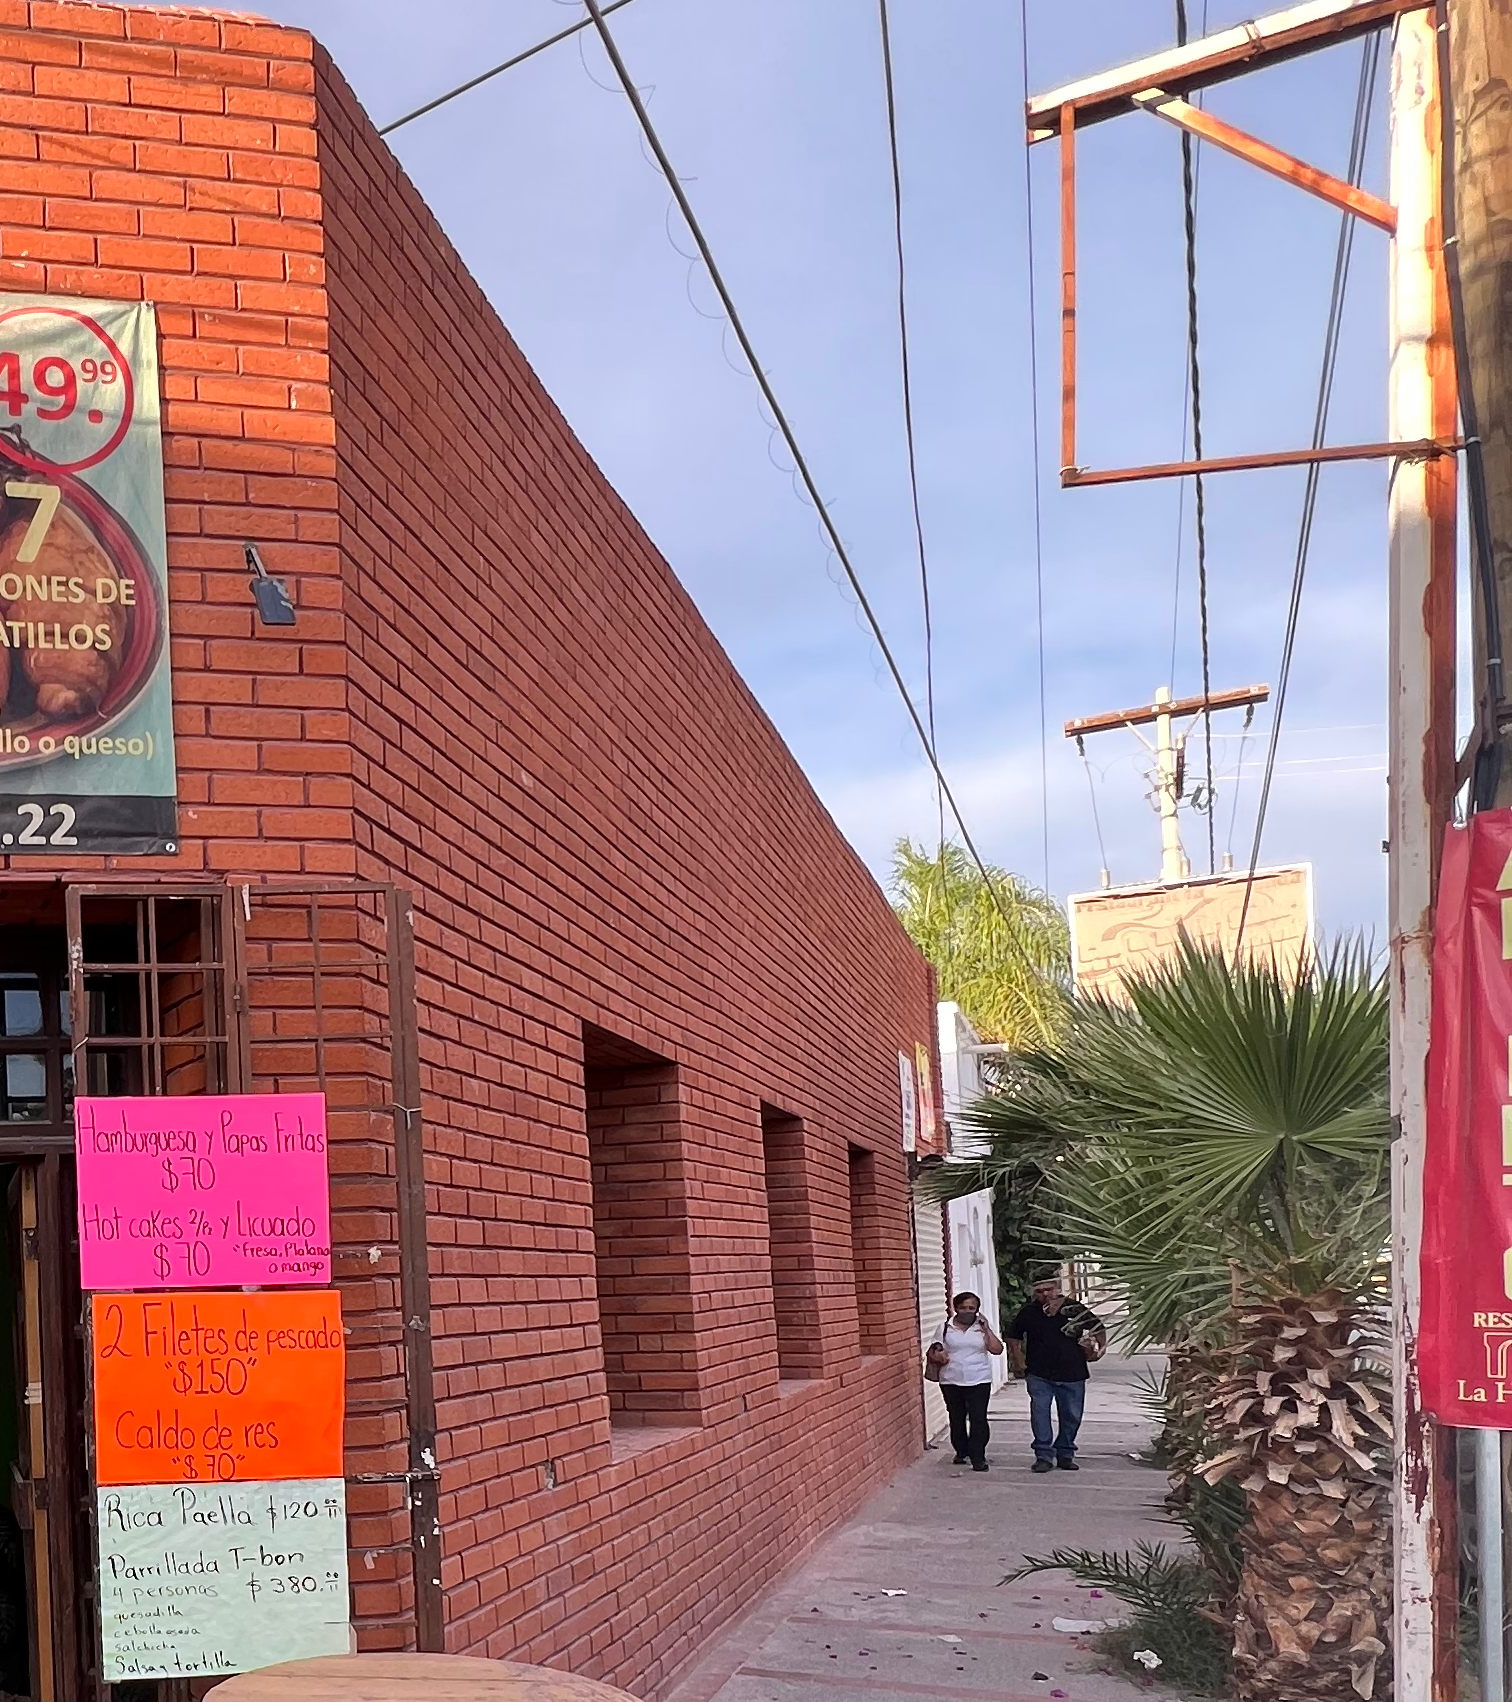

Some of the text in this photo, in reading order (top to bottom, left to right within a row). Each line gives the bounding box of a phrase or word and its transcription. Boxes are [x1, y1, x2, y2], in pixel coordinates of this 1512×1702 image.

[5, 481, 61, 564] 7
[95, 578, 137, 606] DE
[38, 735, 56, 754] o
[63, 731, 155, 761] queso)
[77, 1105, 197, 1157] Hamburguesa
[220, 1110, 268, 1157] Papas
[275, 1112, 326, 1154] Fritas
[162, 1157, 216, 1193] $70
[82, 1203, 123, 1241] Hot
[237, 1200, 316, 1238] Licuado
[153, 1241, 211, 1281] $70
[268, 1261, 325, 1276] o mango
[100, 1301, 342, 1359] 2 Filetes de pescado
[1457, 1379, 1487, 1402] La
[116, 1409, 279, 1451] Caldo de res
[105, 1493, 163, 1532] Rica
[172, 1486, 254, 1527] Paella
[108, 1545, 304, 1580] Parrillada T-bon
[132, 1583, 219, 1605] personas
[173, 1650, 237, 1672] tortilla
